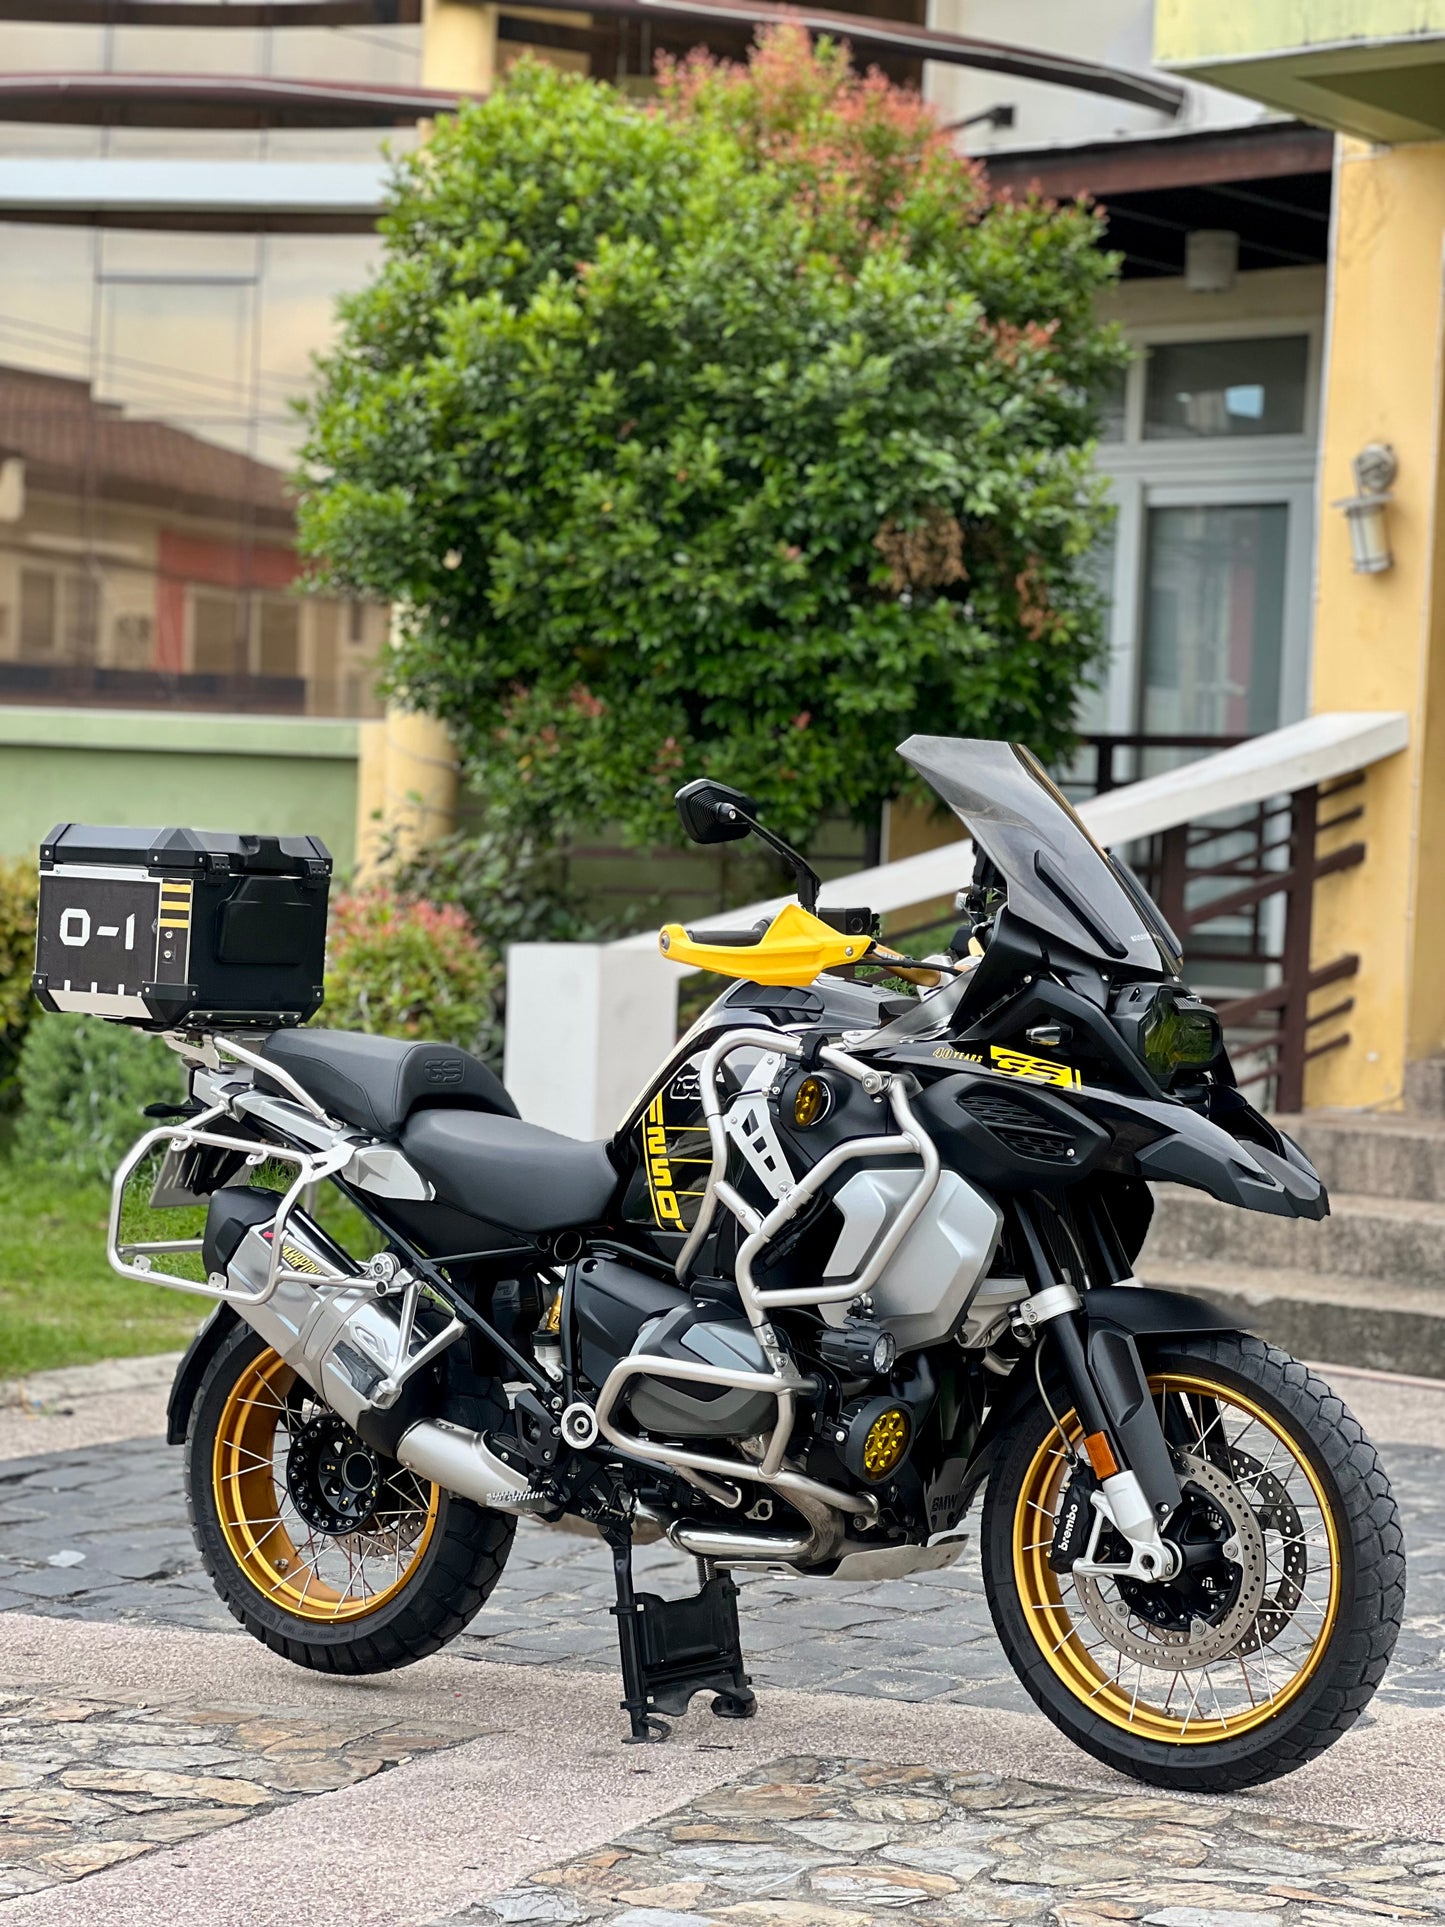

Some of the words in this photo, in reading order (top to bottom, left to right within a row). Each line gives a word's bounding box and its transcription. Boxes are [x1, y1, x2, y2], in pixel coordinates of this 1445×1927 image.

[952, 1051, 983, 1064] YEARS
[424, 1059, 465, 1085] GS
[1057, 1503, 1079, 1552] brembo
